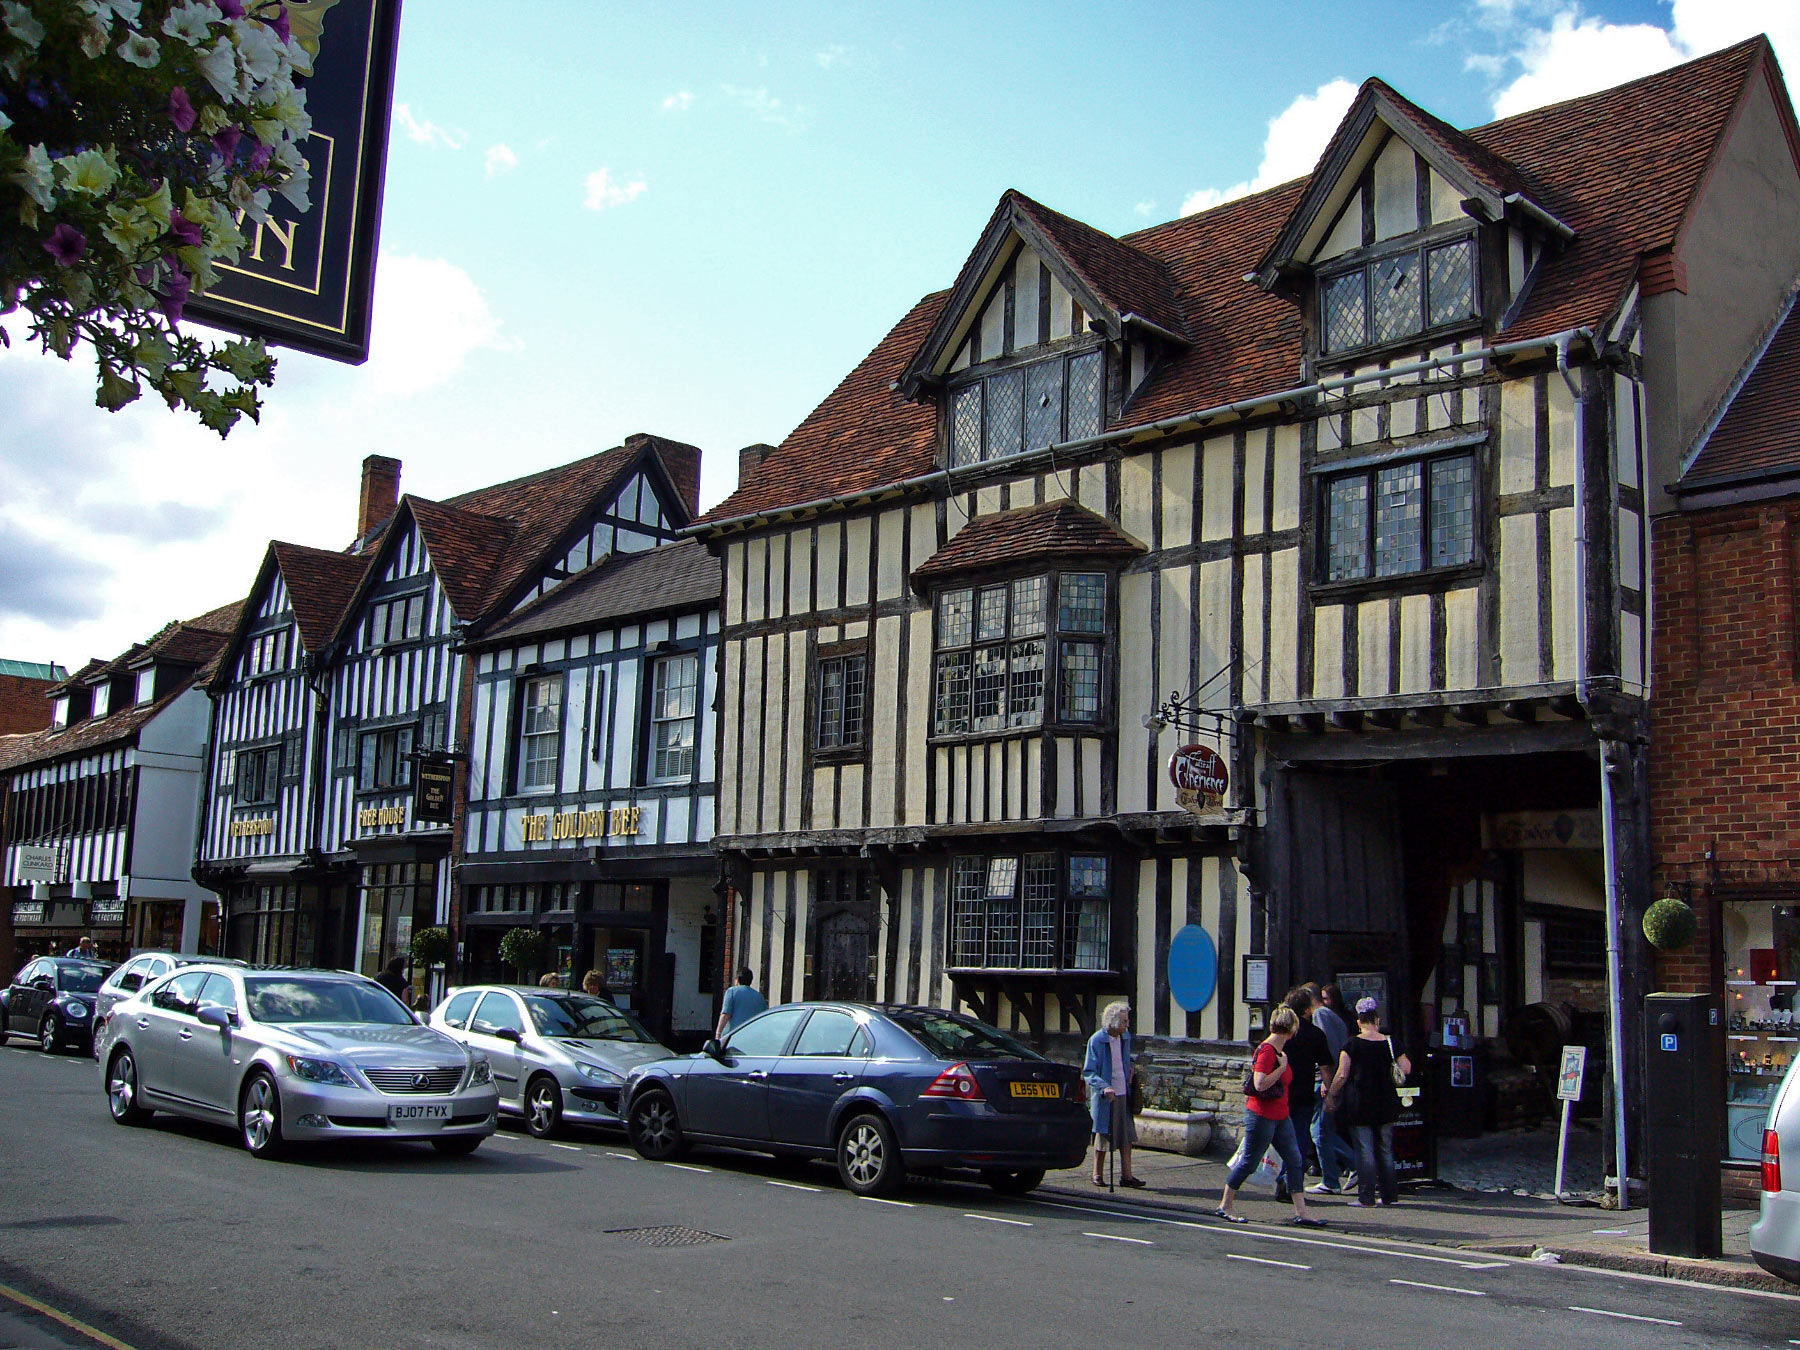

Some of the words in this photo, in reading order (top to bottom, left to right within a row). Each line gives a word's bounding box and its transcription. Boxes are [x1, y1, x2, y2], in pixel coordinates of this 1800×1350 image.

[359, 808, 378, 827] FREE
[378, 805, 405, 826] HOUSE
[231, 818, 273, 837] WETHERSPOON
[521, 814, 548, 842] THE
[552, 811, 605, 840] GOLDEN
[610, 807, 641, 837] BEE
[101, 913, 123, 922] FOOTWEA
[1665, 1037, 1674, 1049] P
[1014, 1083, 1039, 1096] LB56
[395, 1106, 425, 1118] BJ07
[426, 1105, 448, 1117] FVX
